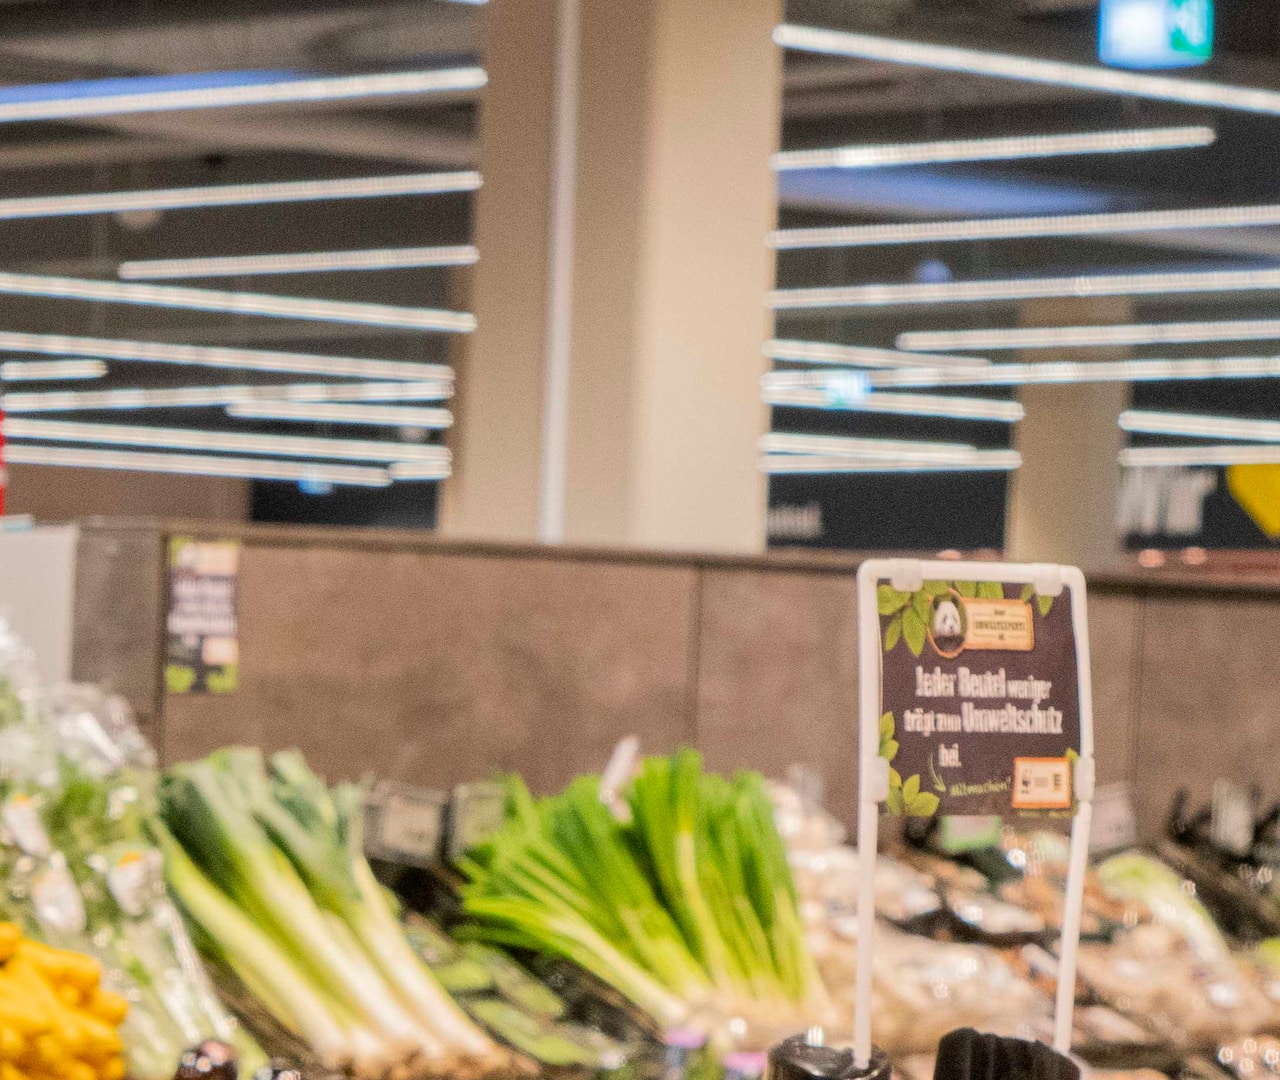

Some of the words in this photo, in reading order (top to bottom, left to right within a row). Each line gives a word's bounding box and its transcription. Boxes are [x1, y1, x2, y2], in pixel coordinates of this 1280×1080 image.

[915, 665, 956, 698] Jeder
[958, 666, 1007, 698] Beutel
[1007, 674, 1053, 704] weniger
[904, 708, 935, 737] trägt
[936, 713, 962, 733] zum
[962, 702, 1064, 735] Umweltschutz
[939, 743, 963, 768] bei.
